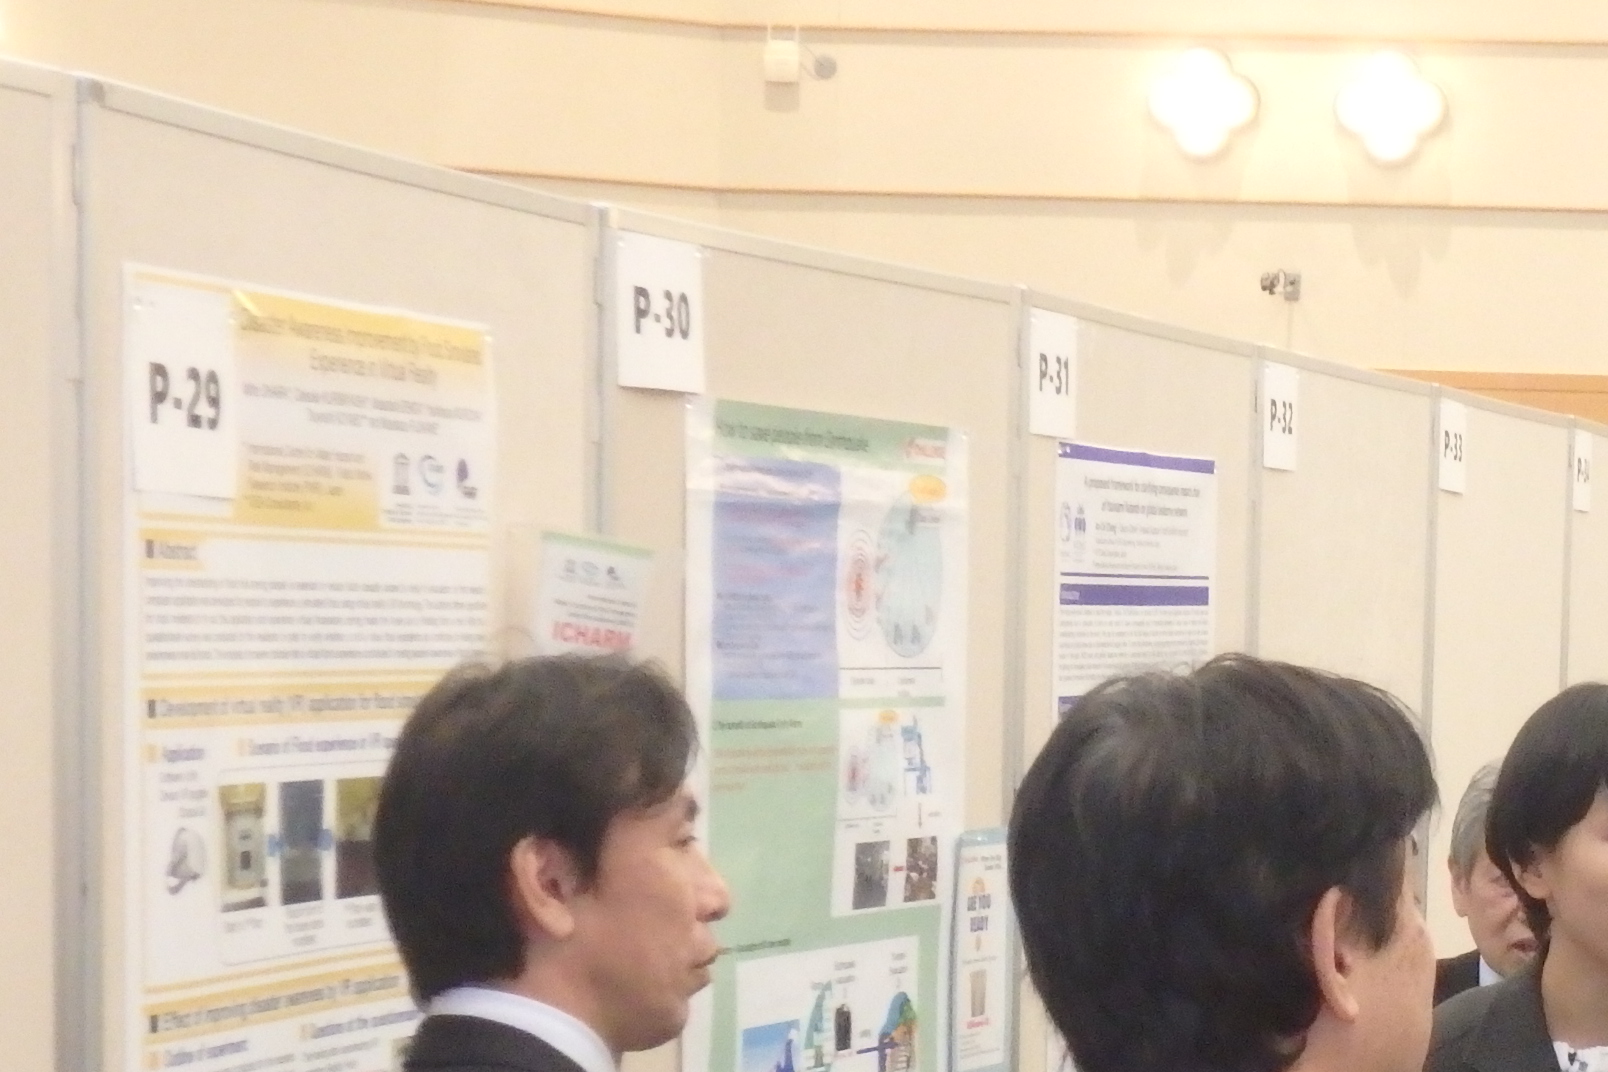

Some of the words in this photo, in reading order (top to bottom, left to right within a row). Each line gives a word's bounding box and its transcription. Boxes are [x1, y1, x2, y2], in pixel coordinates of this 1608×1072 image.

[634, 285, 690, 341] P-30
[1038, 353, 1070, 397] P-31
[149, 362, 221, 431] P-29
[1270, 399, 1293, 436] P-32
[1444, 430, 1463, 462] P-33
[552, 619, 633, 653] ICHARM
